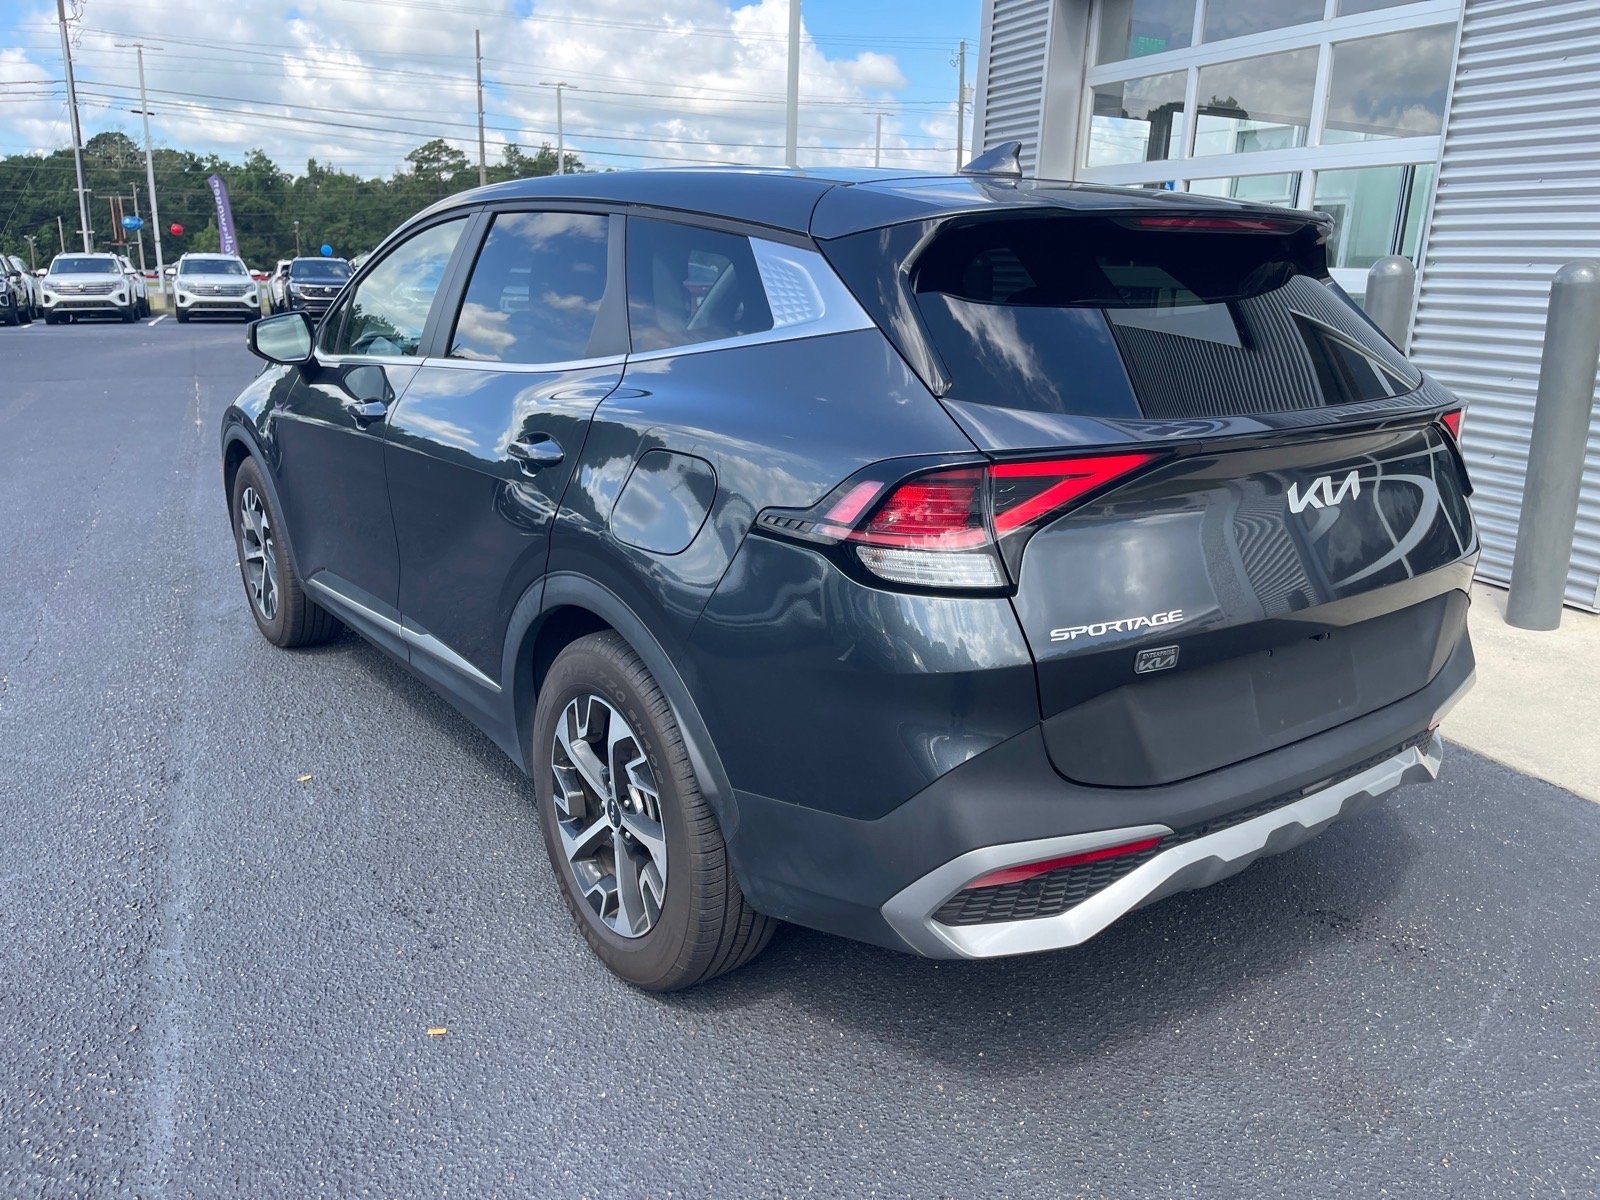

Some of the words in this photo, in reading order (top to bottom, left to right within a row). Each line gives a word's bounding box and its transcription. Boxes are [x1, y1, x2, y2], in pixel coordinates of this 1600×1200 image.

[1287, 470, 1361, 514] KIA
[1050, 609, 1183, 641] SPORTAGE
[1138, 655, 1175, 670] KIA
[1142, 649, 1176, 660] ENTERPRISE
